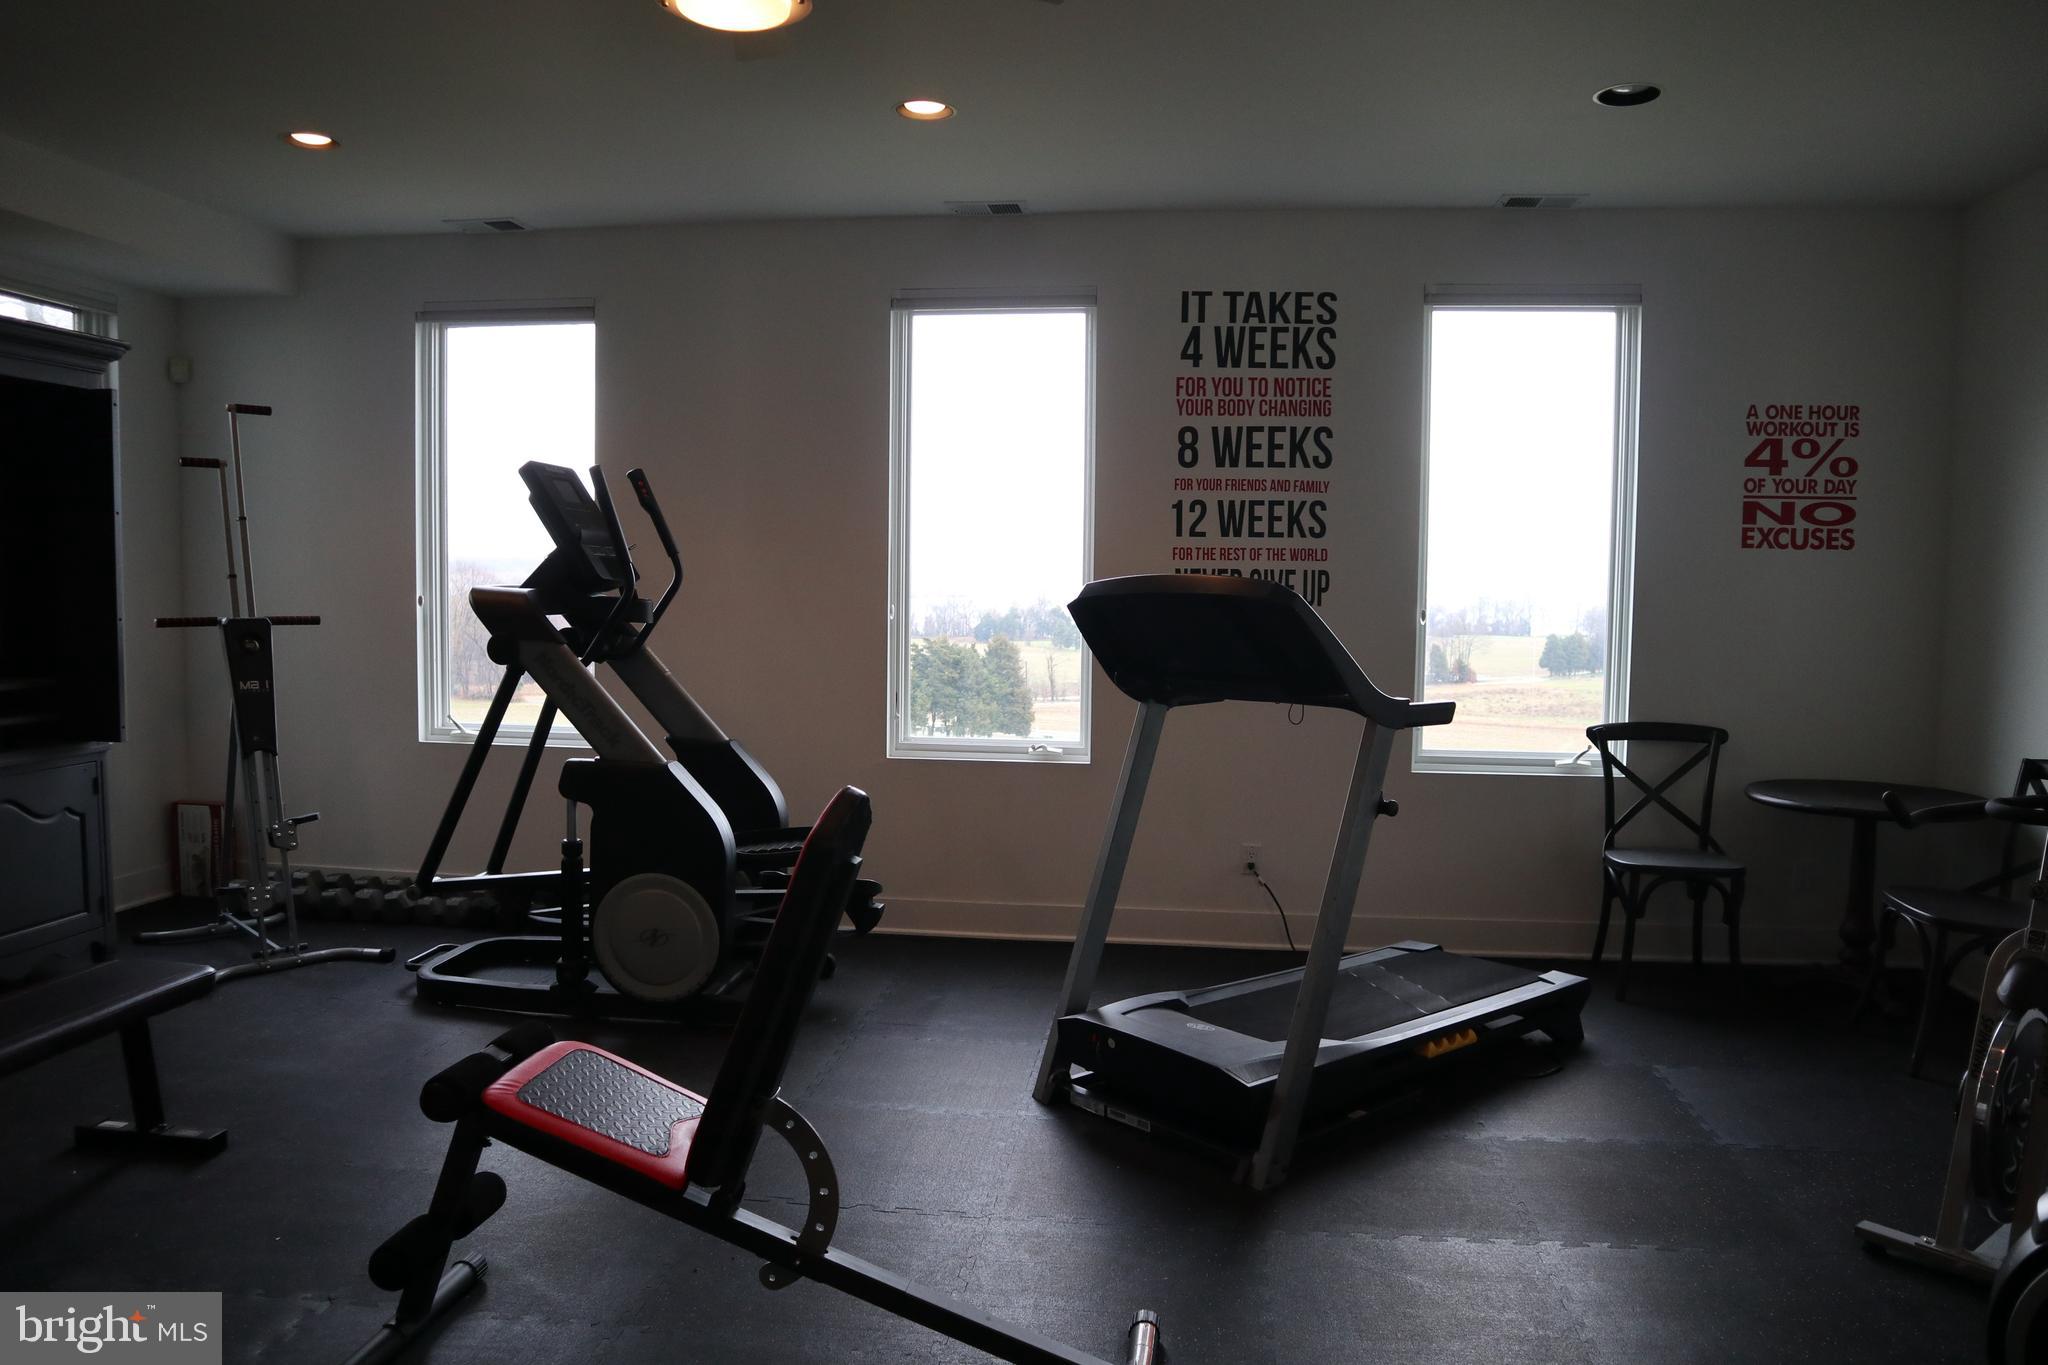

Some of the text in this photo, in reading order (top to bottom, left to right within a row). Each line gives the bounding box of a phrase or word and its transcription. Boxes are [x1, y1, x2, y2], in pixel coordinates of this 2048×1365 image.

[1180, 290, 1337, 325] IT TAKES
[1180, 325, 1337, 370] 4 WEEKS
[1176, 376, 1333, 398] FOR YOU TO NOTICE
[1176, 399, 1333, 418] YOUR BODY CHANGING
[1746, 404, 1860, 421] A ONE HOUR
[1746, 421, 1860, 438] WORKOUT IS
[1177, 426, 1334, 470] 8 WEEKS
[1743, 437, 1859, 478] 4%
[1174, 478, 1330, 494] FOR YOUR FRIENDS AND FAMILY
[1743, 478, 1858, 495] OF YOUR DAY
[1171, 500, 1328, 539] 12 WEEKS
[1742, 501, 1857, 527] NO
[1741, 527, 1856, 551] EXCUSES
[1172, 547, 1328, 562] FOR THE REST OF THE WORLD
[1303, 569, 1330, 607] UP
